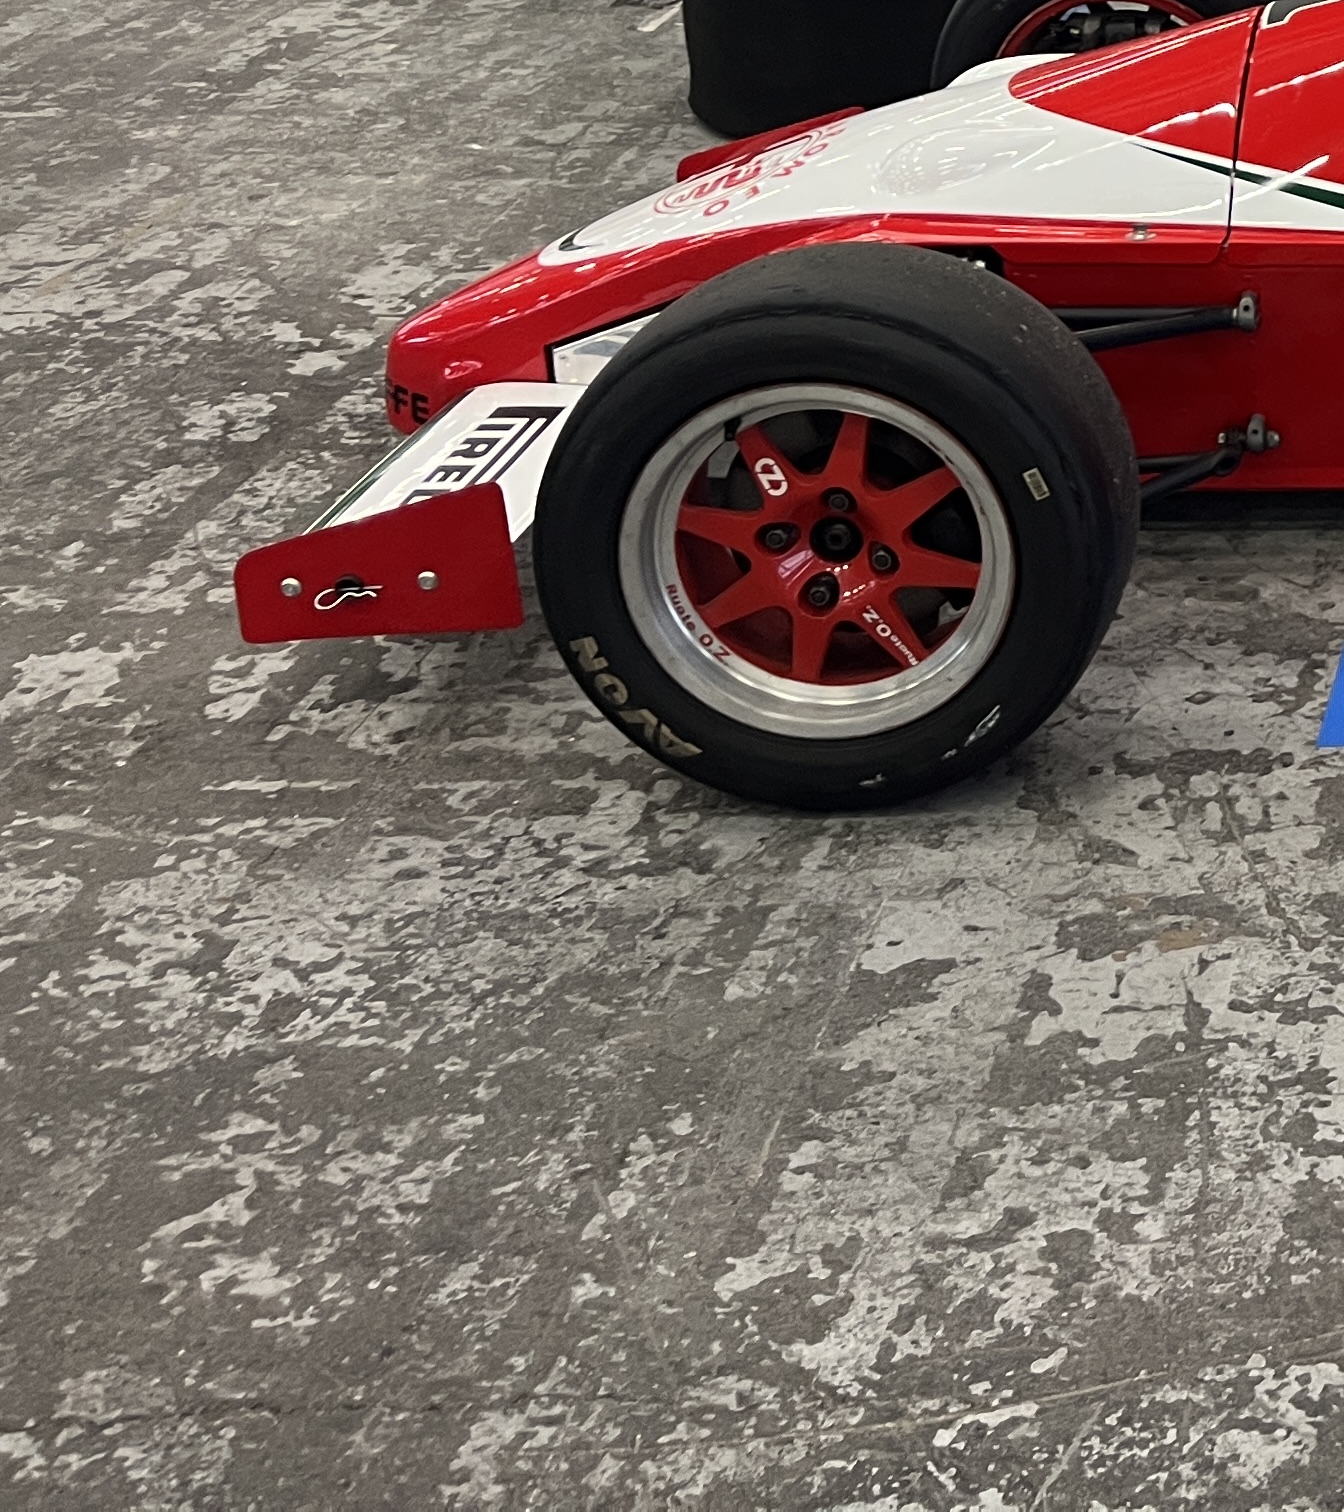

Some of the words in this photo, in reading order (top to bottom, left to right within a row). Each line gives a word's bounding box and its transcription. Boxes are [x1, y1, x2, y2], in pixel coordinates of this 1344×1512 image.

[399, 406, 567, 506] PIREL
[666, 583, 696, 632] Ruote
[569, 636, 703, 758] AVON
